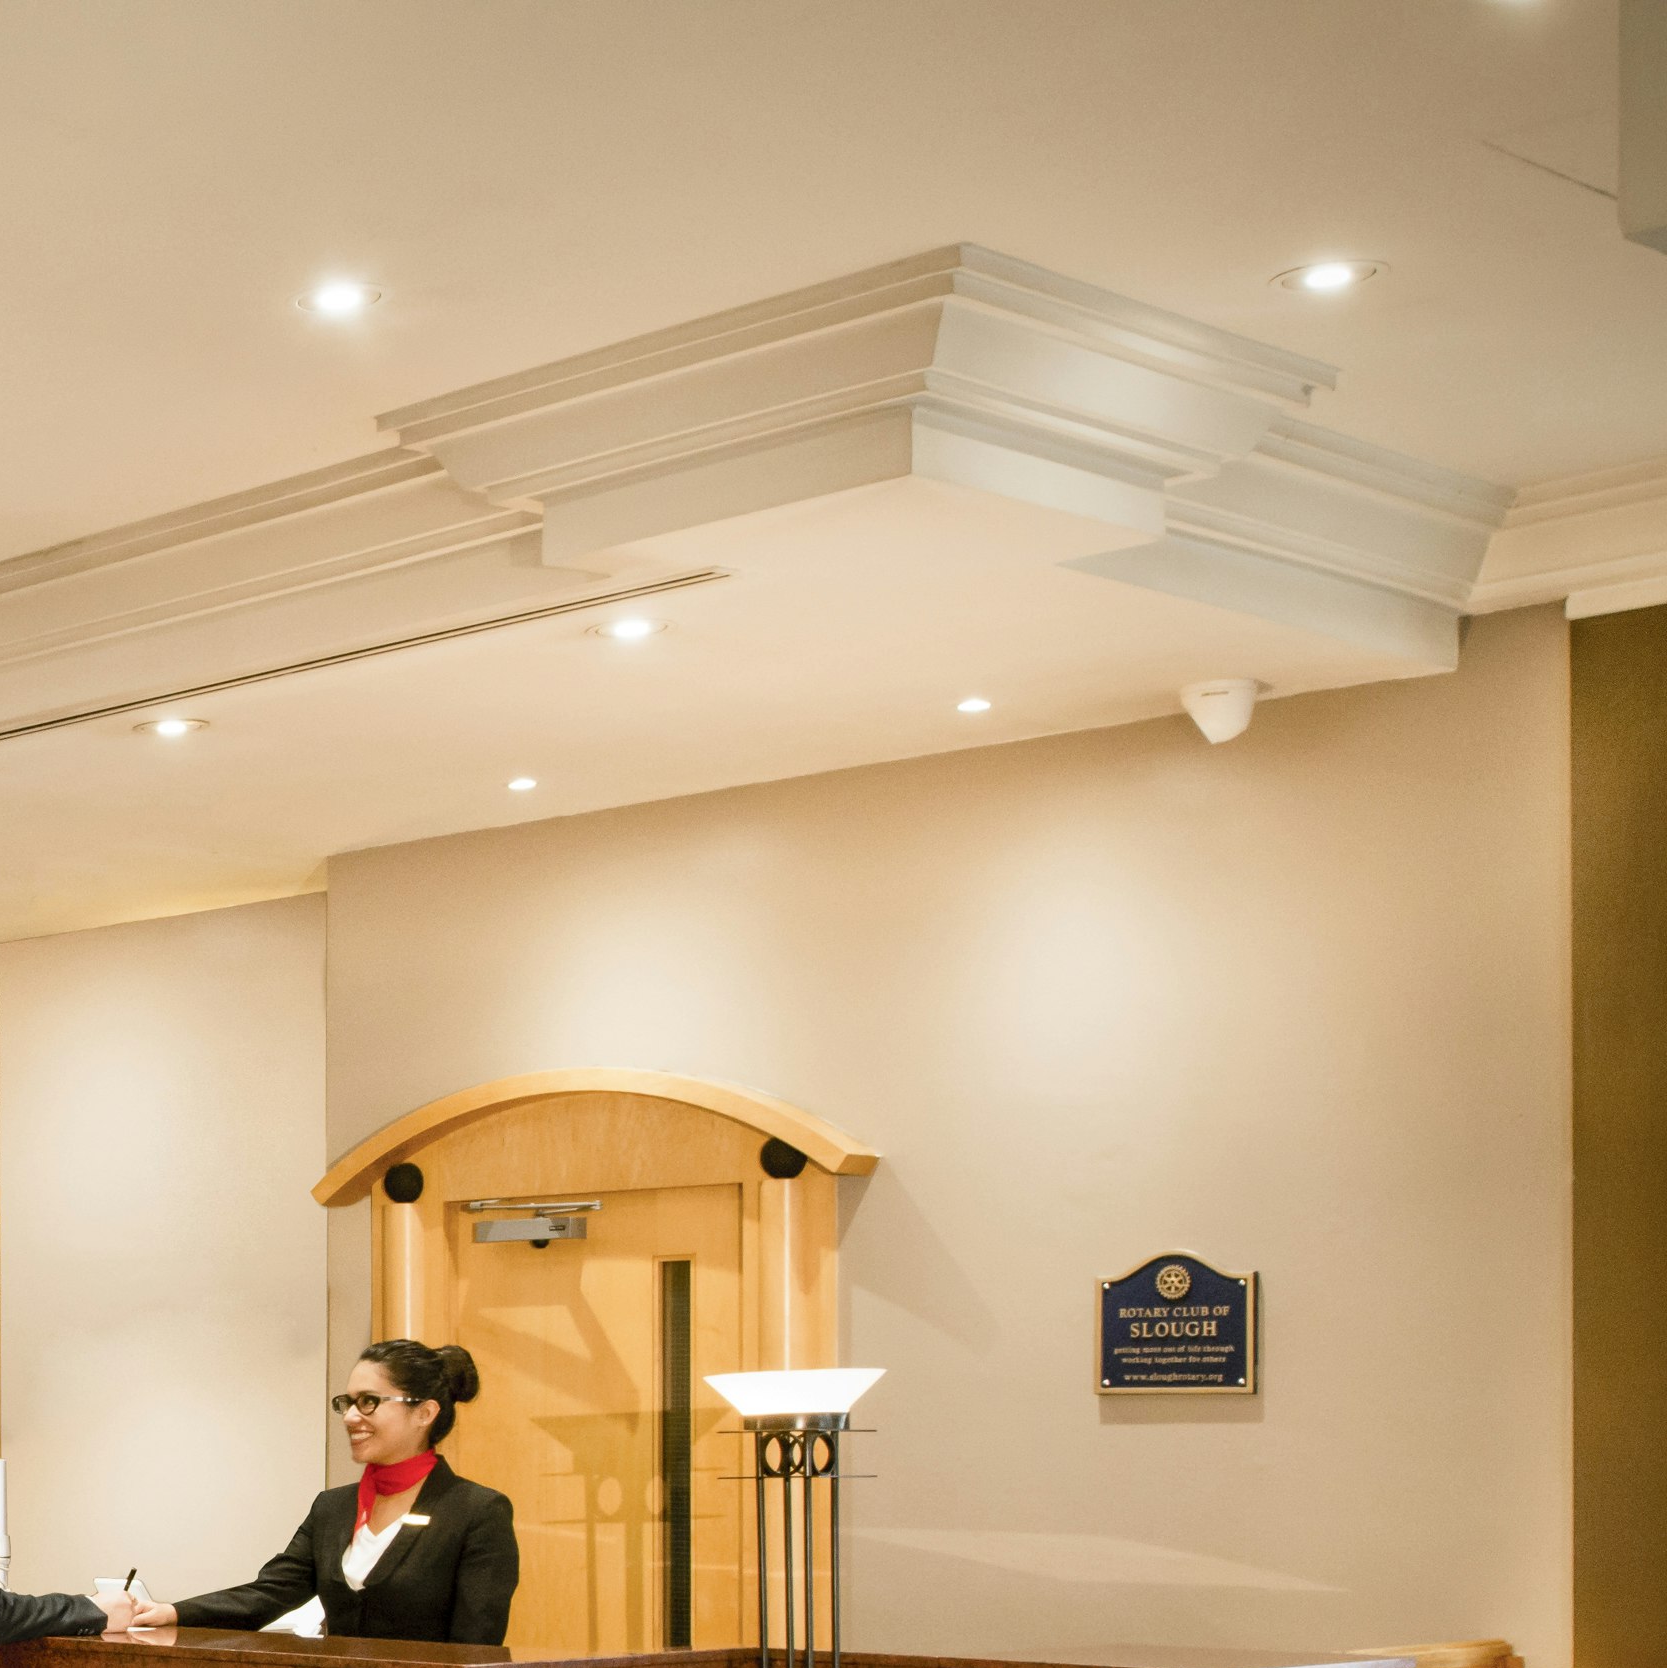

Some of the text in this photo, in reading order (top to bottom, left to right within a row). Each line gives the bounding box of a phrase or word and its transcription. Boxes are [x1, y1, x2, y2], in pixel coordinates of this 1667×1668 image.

[1119, 1305, 1231, 1318] ROTARY CLUB OF
[1130, 1320, 1218, 1338] SLOUGH
